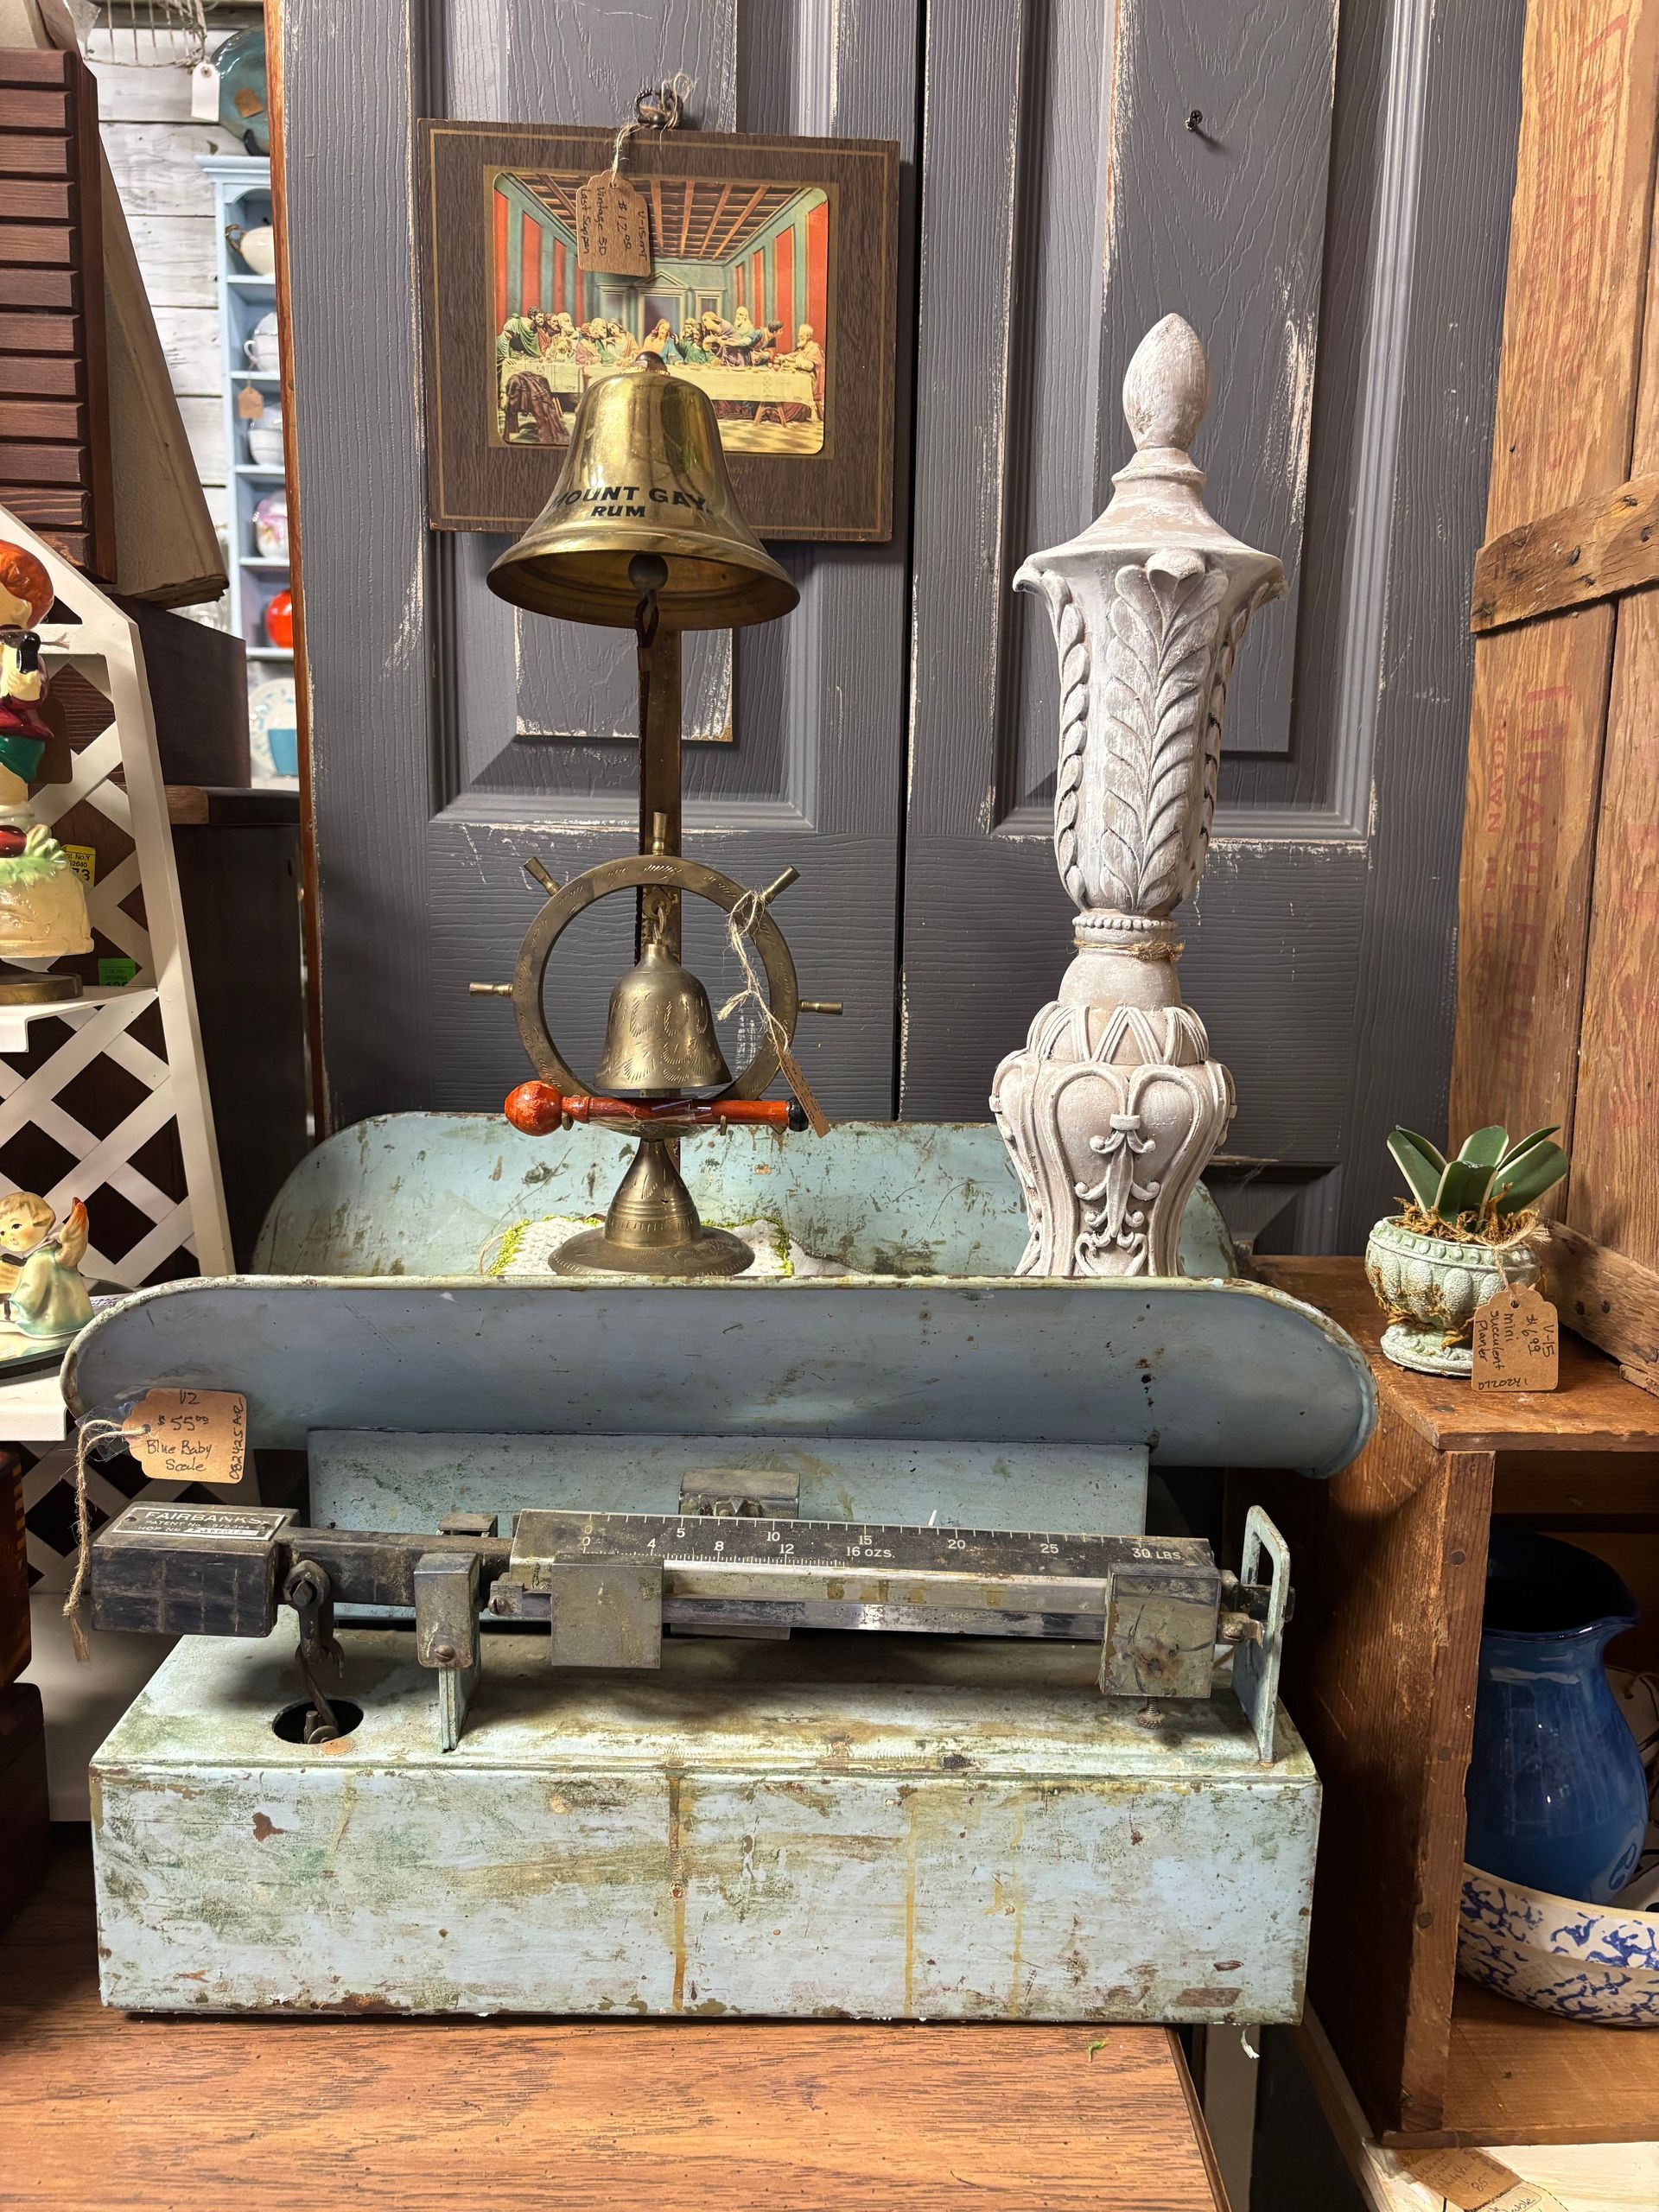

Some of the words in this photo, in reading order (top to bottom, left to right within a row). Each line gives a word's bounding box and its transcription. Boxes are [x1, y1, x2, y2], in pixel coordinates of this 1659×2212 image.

[580, 188, 592, 211] Last
[594, 186, 608, 231] Vintage
[598, 236, 608, 257] 3D
[590, 505, 646, 518] RUM
[1541, 1324, 1555, 1357] V-15
[146, 1439, 177, 1455] Blue
[181, 1440, 213, 1459] Baby
[165, 1457, 207, 1472] Scale
[581, 1536, 591, 1546] 0
[646, 1538, 657, 1549] 4
[713, 1541, 724, 1551] 8
[779, 1543, 794, 1554] 12
[846, 1546, 861, 1557] 16
[584, 1524, 593, 1535] 0
[676, 1528, 686, 1538] 5
[766, 1531, 780, 1541] 10
[858, 1535, 873, 1545] 15
[947, 1539, 966, 1549] 20
[1041, 1543, 1059, 1554] 25
[1131, 1547, 1151, 1559] 30
[1155, 1551, 1185, 1560] LBS.
